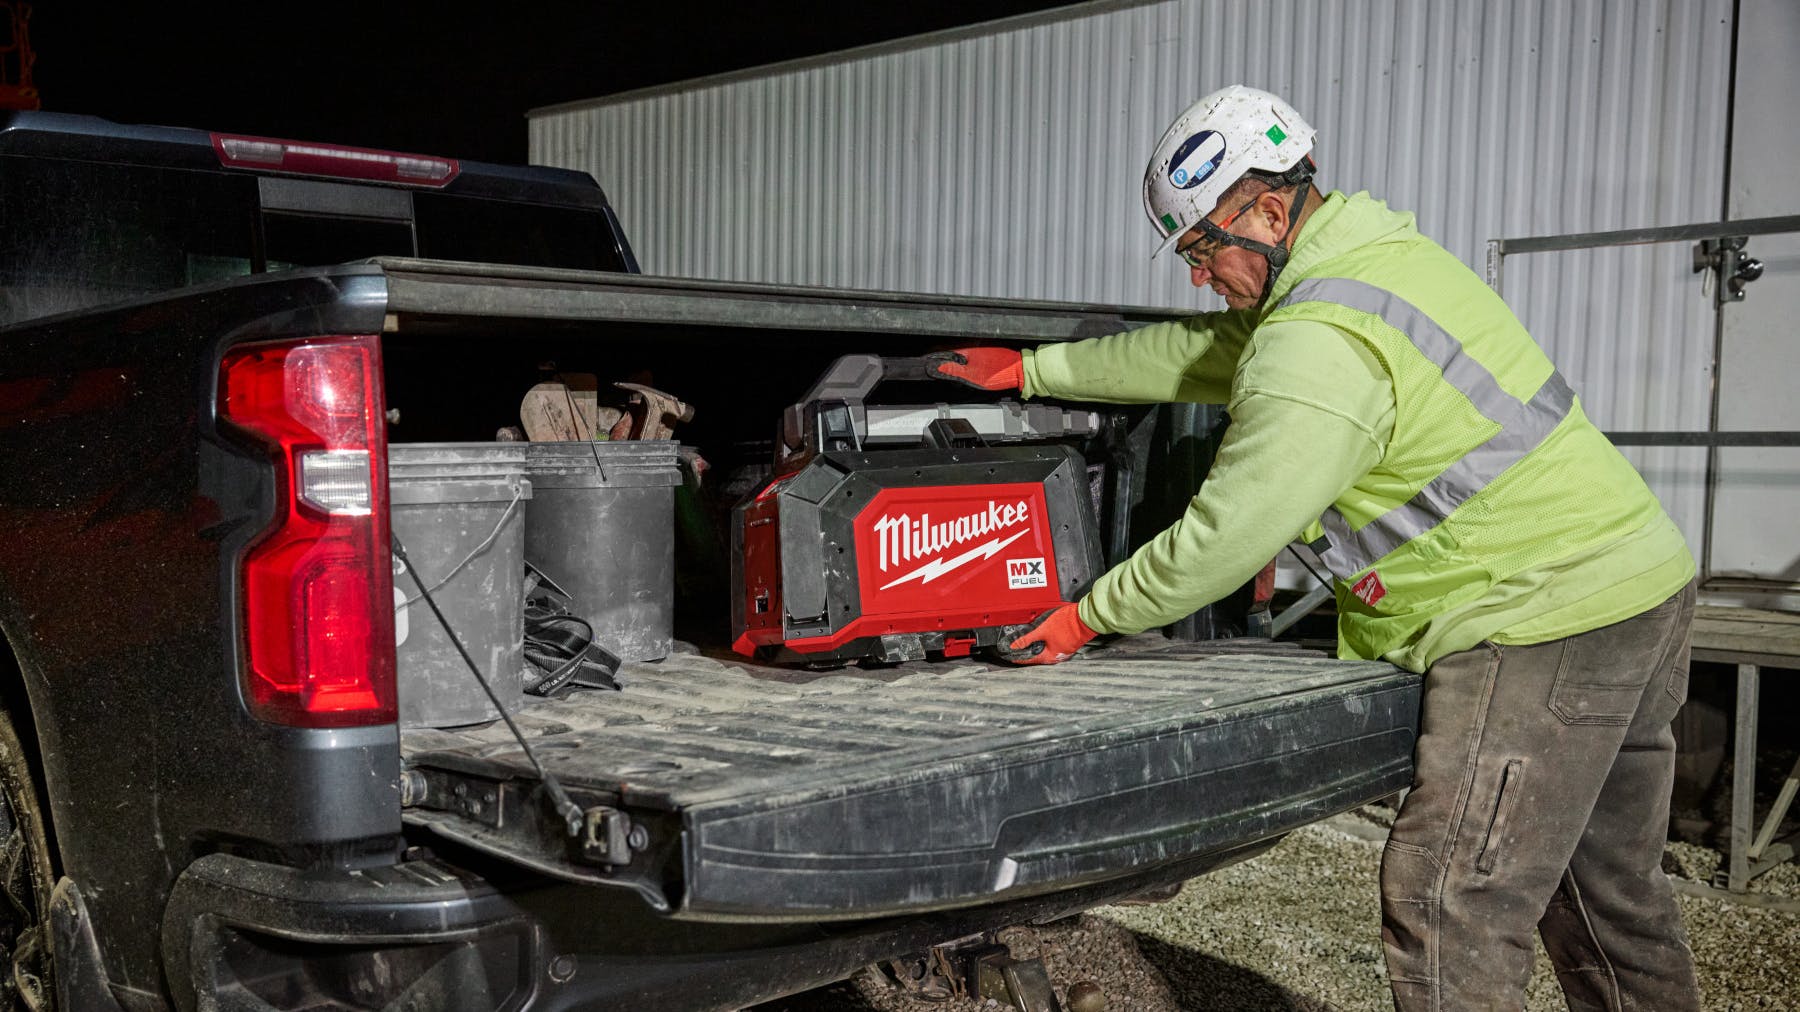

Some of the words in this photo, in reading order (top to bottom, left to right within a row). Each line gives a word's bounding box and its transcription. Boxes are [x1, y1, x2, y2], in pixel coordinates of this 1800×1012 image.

[873, 500, 1029, 573] Milwaukee
[1010, 561, 1044, 577] MX
[1011, 577, 1045, 586] FUEL
